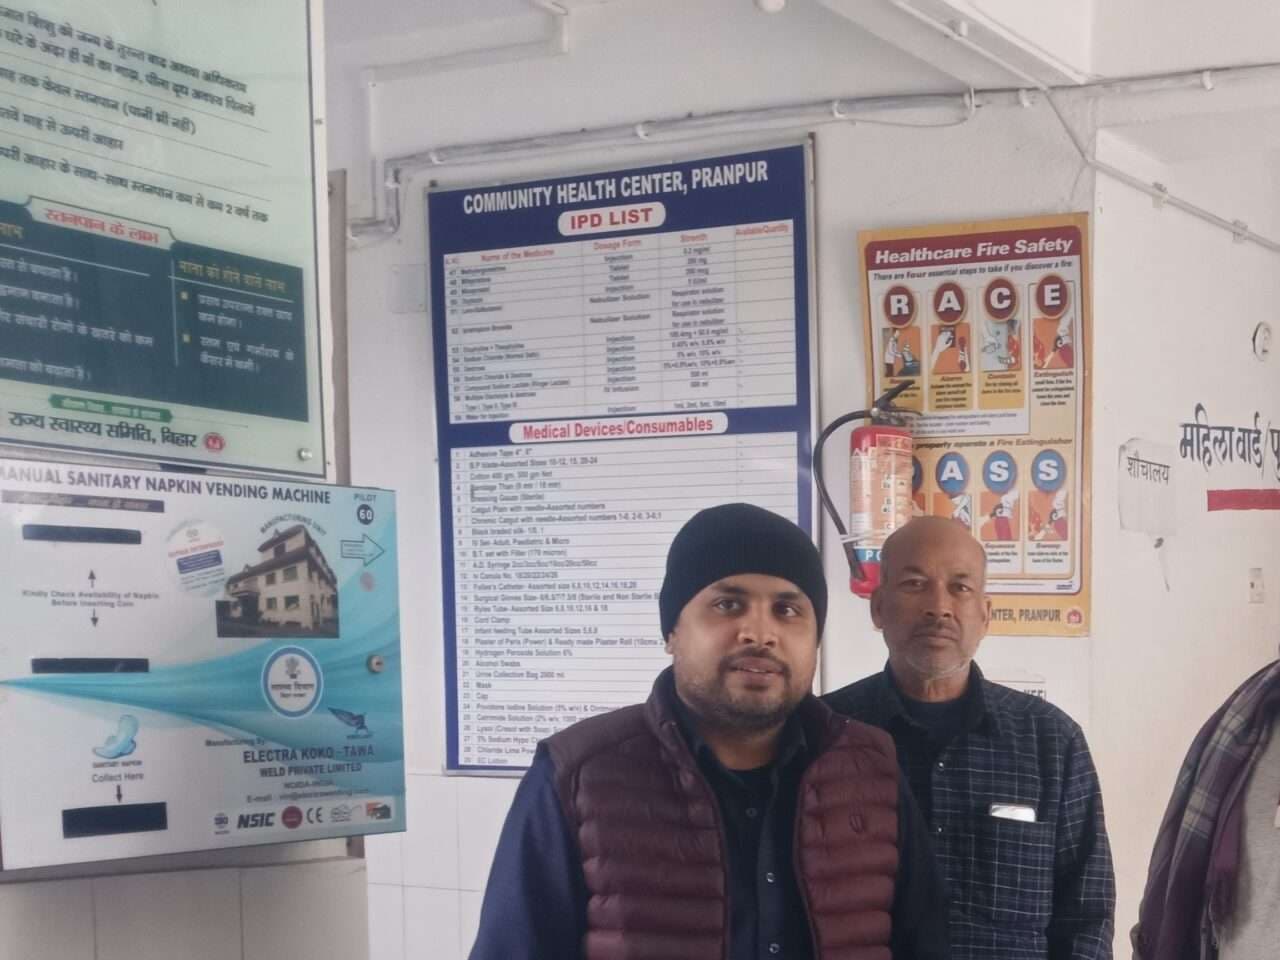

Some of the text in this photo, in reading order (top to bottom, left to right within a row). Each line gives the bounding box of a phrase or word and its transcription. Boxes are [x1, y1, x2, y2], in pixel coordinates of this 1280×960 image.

[59, 22, 73, 37] को
[463, 160, 768, 215] COMMUNITY HEALTH CENTER, PRANPUR
[225, 204, 233, 215] 2
[571, 208, 653, 230] IPD LIST
[110, 221, 125, 236] के
[875, 237, 1073, 265] Healthcare Fire Safety
[873, 271, 892, 281] There
[894, 271, 905, 280] are
[928, 267, 957, 277] essential
[959, 266, 977, 276] steps
[979, 266, 986, 274] to
[987, 264, 1003, 273] take
[1004, 263, 1009, 272] if
[1010, 263, 1023, 273] you
[1024, 261, 1053, 271] discover
[1060, 259, 1073, 269] fire
[889, 284, 1061, 316] R A C E
[8, 411, 198, 448] राज्य स्वास्थ्य समिति, बिहार
[522, 423, 571, 441] Medical
[954, 440, 987, 449] operate
[997, 438, 1013, 446] Fire
[940, 459, 1058, 482] A S S
[1127, 450, 1170, 485] शौचालय
[67, 470, 331, 504] SANITARY NAPKIN VENDING MACHINE
[359, 508, 373, 521] 60
[50, 590, 75, 599] Check
[123, 591, 131, 599] of
[51, 599, 77, 607] Before
[1019, 608, 1061, 623] PRANPUR
[243, 744, 375, 764] ELECTRA KOKO TAWA
[92, 771, 145, 783] Collect Here
[260, 762, 362, 778] WELD PRIVATE LIMITED
[237, 812, 276, 830] NSIC
[306, 806, 323, 824] CE
